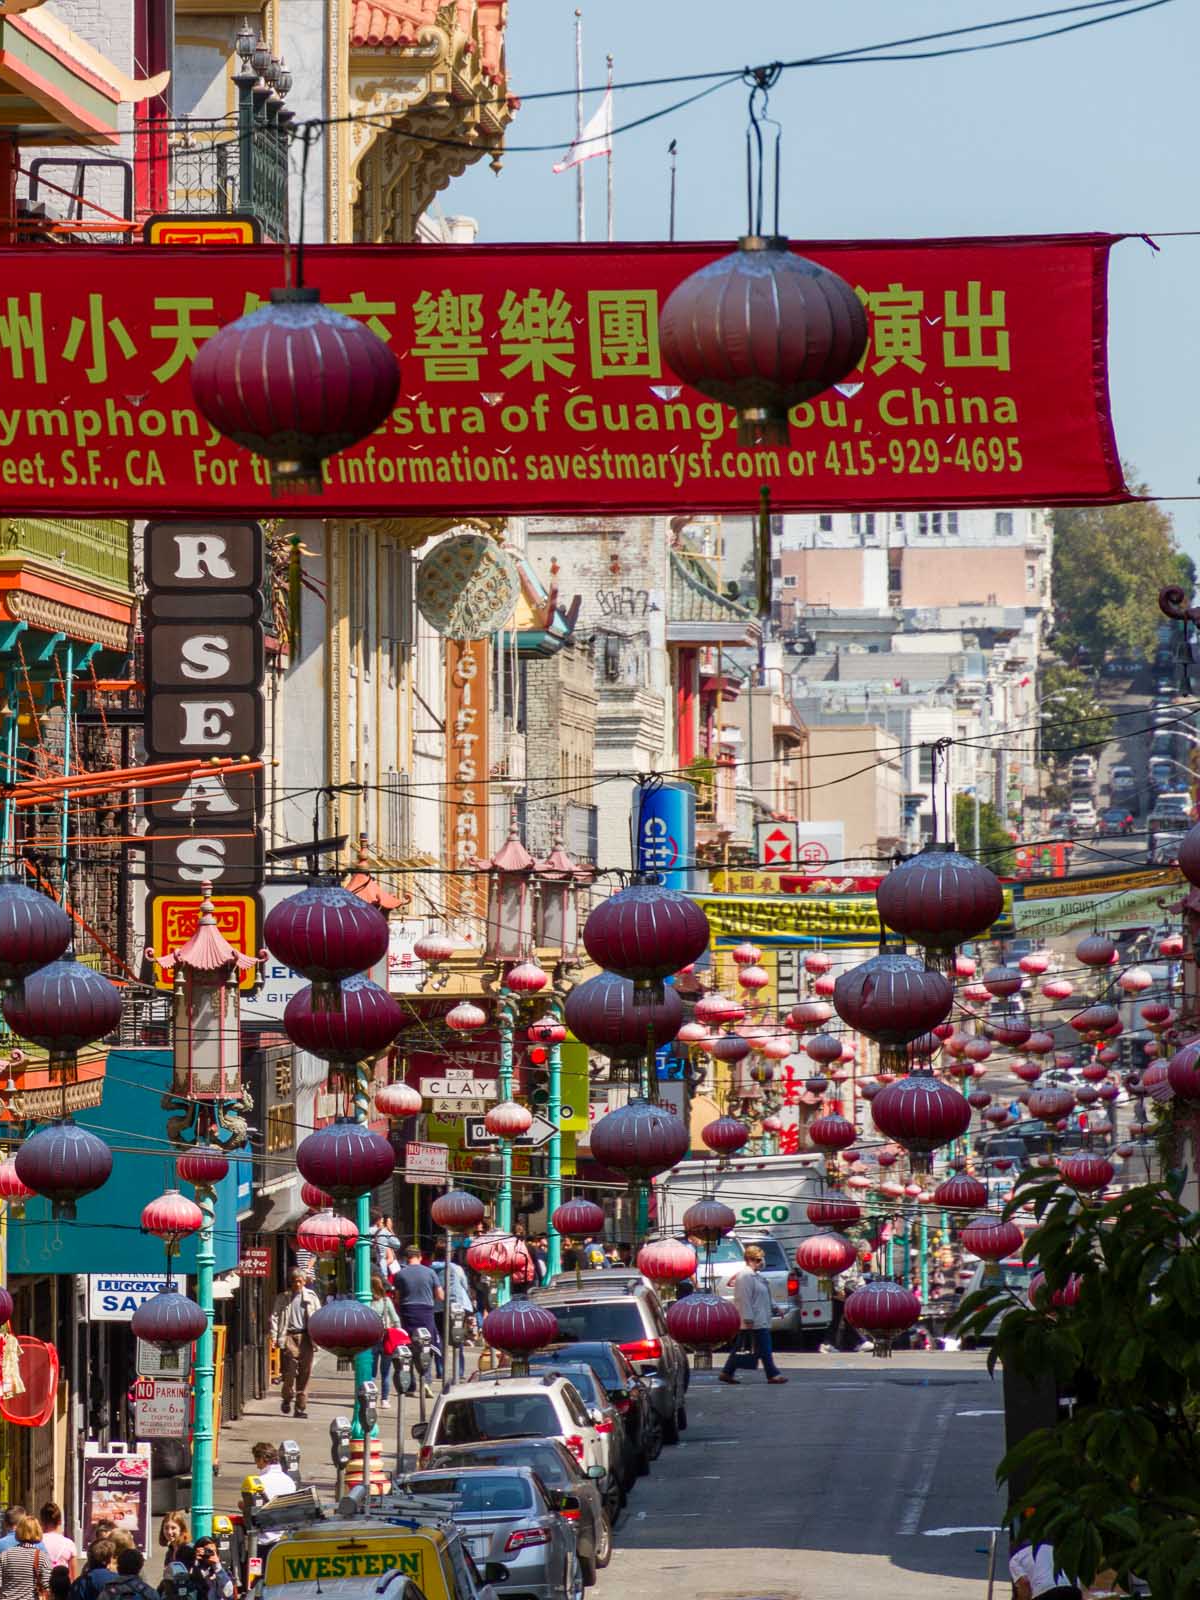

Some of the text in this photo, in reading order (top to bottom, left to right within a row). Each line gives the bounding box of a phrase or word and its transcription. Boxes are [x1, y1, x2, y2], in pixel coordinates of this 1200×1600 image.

[501, 393, 549, 432] of
[878, 386, 1017, 426] China
[125, 449, 166, 486] CA
[193, 449, 240, 486] For
[338, 446, 518, 484] information:
[525, 440, 781, 488] savestmarysf.com
[788, 449, 817, 478] or
[824, 436, 1023, 478] 415-929-4695
[703, 901, 830, 917] CHINATOWN
[721, 915, 880, 932] MUSIC FESTIVA
[443, 1050, 526, 1065] JEWELY
[430, 1081, 489, 1095] CLAY
[138, 1383, 188, 1399] NO PARKING
[286, 1552, 421, 1579] WESTERN
